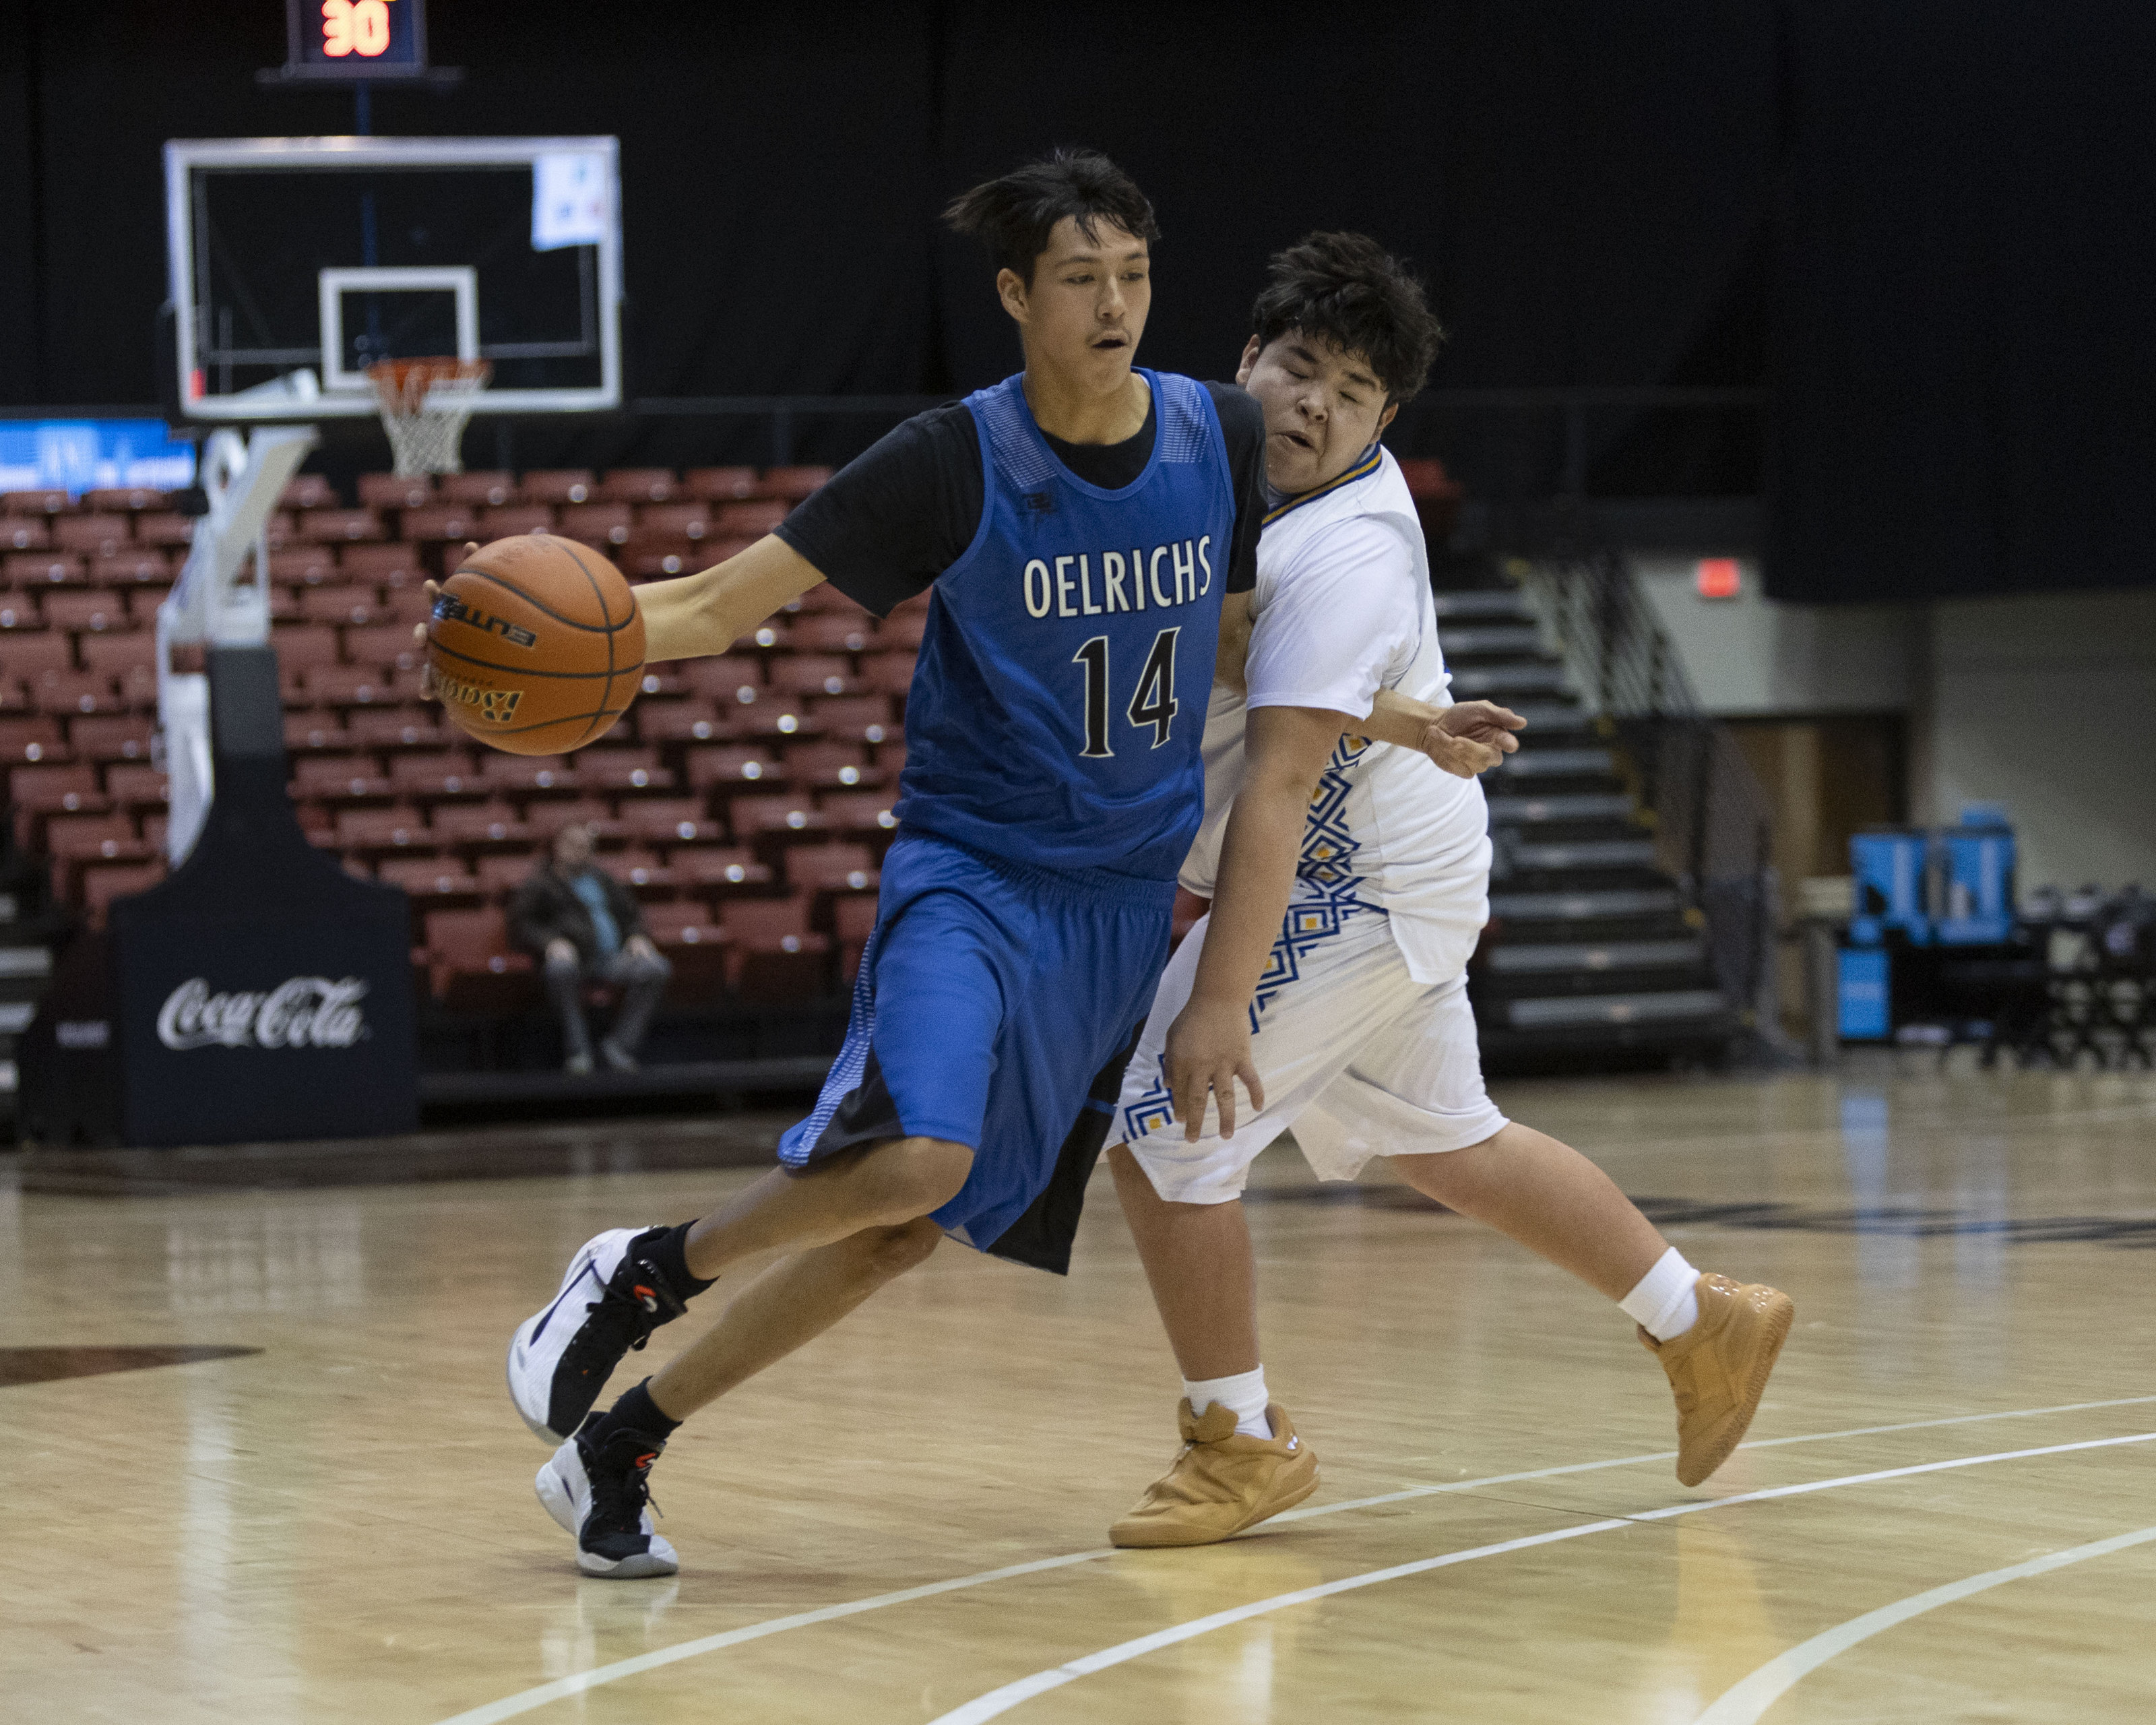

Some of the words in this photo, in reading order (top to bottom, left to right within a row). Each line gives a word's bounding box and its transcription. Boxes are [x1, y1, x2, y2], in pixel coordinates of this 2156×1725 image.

[321, 0, 390, 57] 30
[1023, 535, 1211, 618] OELRICHS
[1072, 626, 1182, 759] 14
